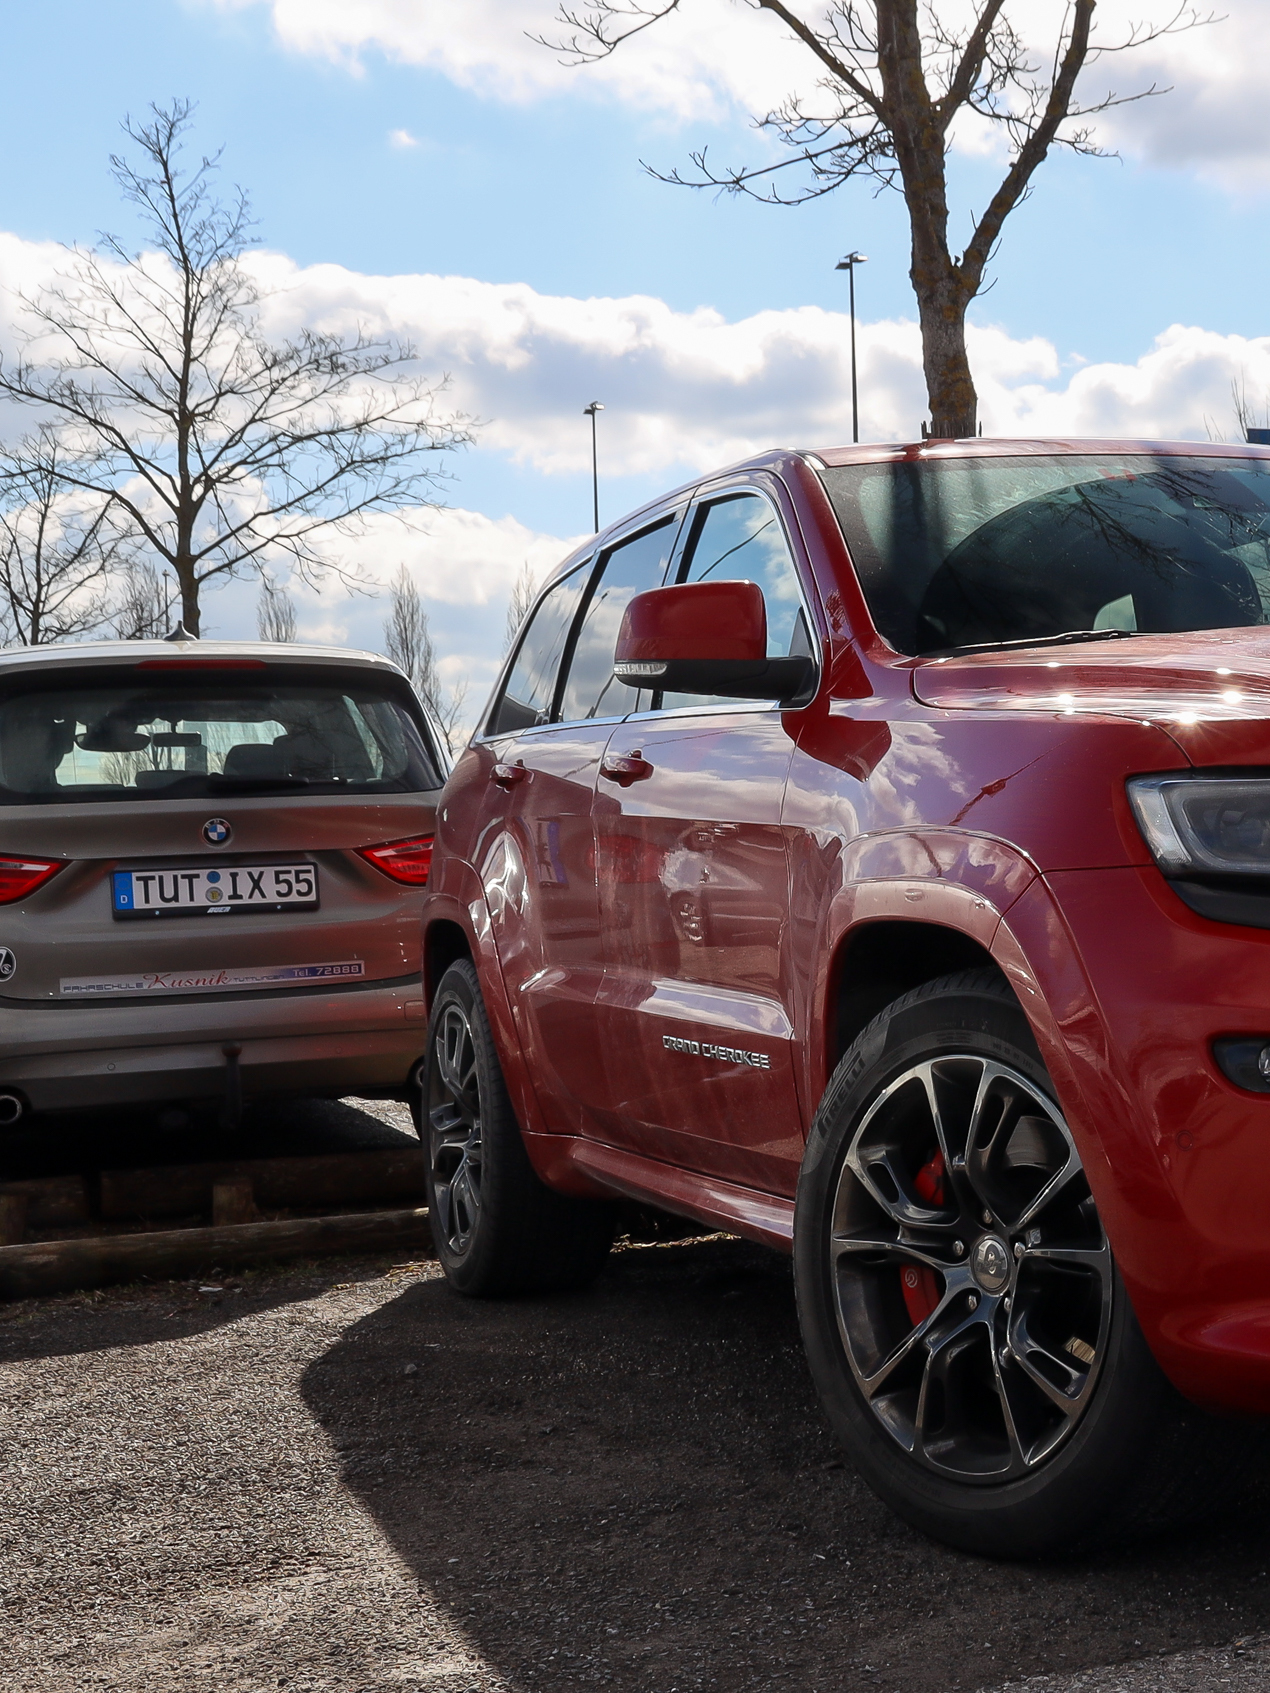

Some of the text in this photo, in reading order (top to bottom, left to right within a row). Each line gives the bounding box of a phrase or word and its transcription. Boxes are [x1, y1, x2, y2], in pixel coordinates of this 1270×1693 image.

[120, 895, 128, 904] D
[136, 869, 314, 905] TUT IX 55
[63, 982, 144, 993] FAHRSCHULE
[143, 970, 230, 989] Kusnik
[292, 969, 312, 977] Tel.
[316, 965, 359, 975] 72888
[662, 1035, 771, 1070] GRAND CHEROKEE
[817, 1050, 867, 1139] PIRELLI
